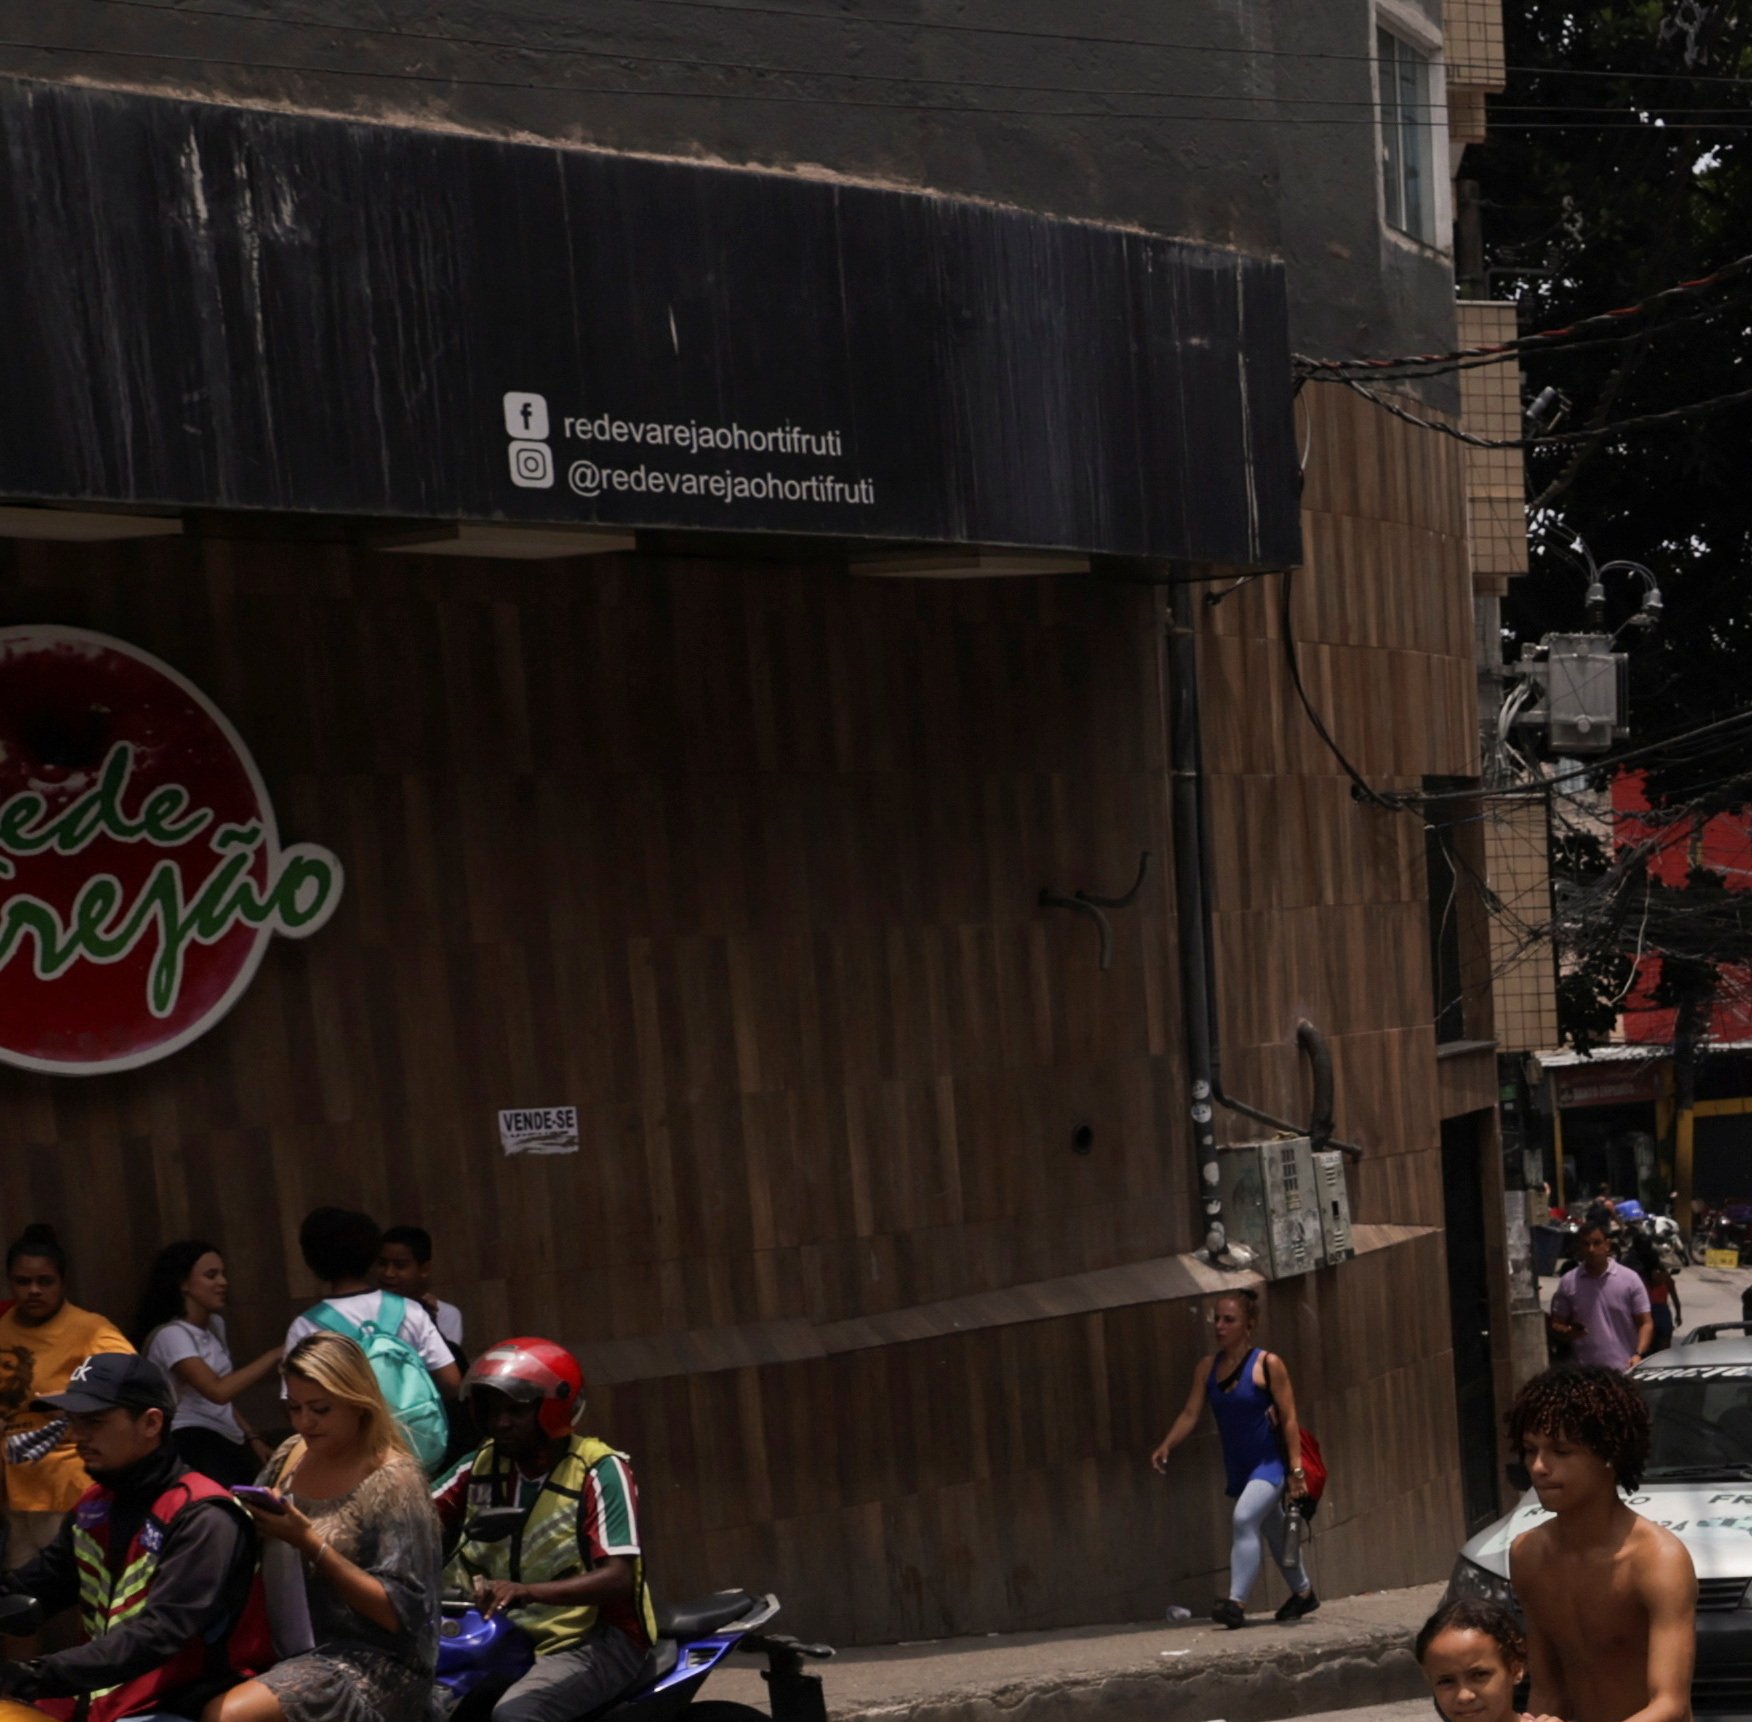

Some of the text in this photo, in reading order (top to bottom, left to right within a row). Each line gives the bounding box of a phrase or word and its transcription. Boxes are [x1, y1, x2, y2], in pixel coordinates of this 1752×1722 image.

[565, 413, 842, 458] redevarejaohortifruti
[567, 459, 876, 506] @redevarejaohortifruti
[0, 744, 212, 853] ede
[503, 1110, 576, 1132] VENDE-SE
